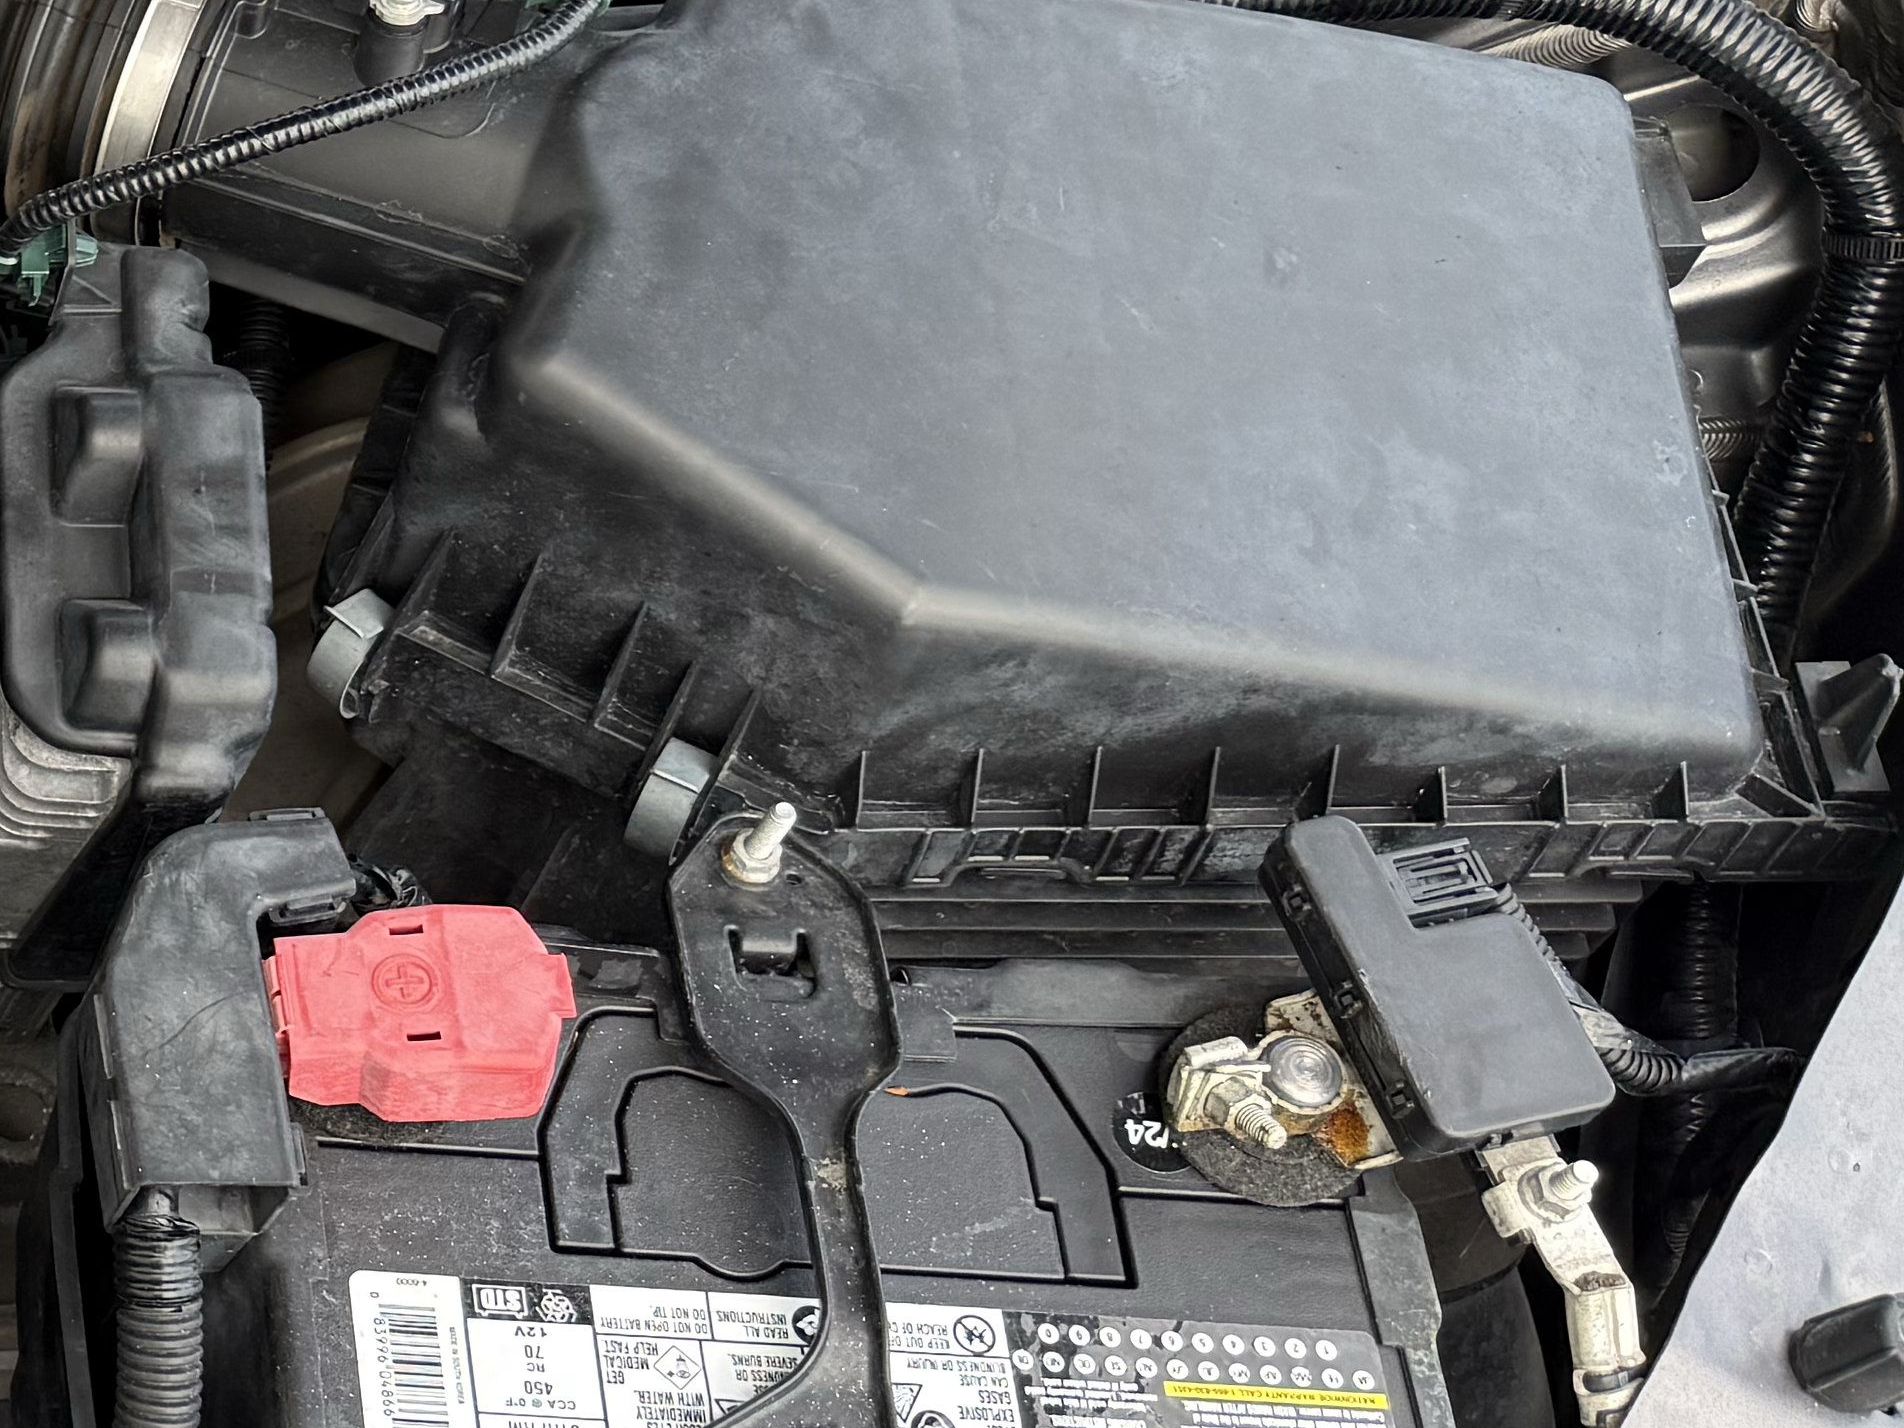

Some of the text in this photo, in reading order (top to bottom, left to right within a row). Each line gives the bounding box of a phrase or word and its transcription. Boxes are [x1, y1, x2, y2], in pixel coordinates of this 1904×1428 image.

[480, 1288, 522, 1310] STD
[670, 1306, 690, 1320] NOT
[600, 1316, 642, 1330] BATTERY
[644, 1320, 670, 1332] OPEN
[674, 1320, 692, 1334] NOT
[902, 1322, 914, 1334] OF
[514, 1326, 548, 1338] 12V
[742, 1324, 788, 1340] READ ALL
[372, 1316, 388, 1364] 83996
[906, 1336, 924, 1348] OUT
[524, 1344, 544, 1360] 70
[632, 1342, 658, 1356] HELP
[526, 1362, 546, 1372] RC
[602, 1356, 650, 1370] MEDICAL
[940, 1360, 954, 1370] OR
[606, 1370, 624, 1384] GET
[734, 1370, 748, 1380] OR
[958, 1374, 1008, 1388] CAN CAUSE
[378, 1370, 396, 1416] 04866
[524, 1380, 554, 1394] 450
[676, 1392, 704, 1406] WITH
[978, 1390, 1012, 1404] GASES
[546, 1400, 576, 1410] CCA
[636, 1406, 706, 1424] IMMEDIATELY
[956, 1406, 1014, 1422] EXPLOSIVE
